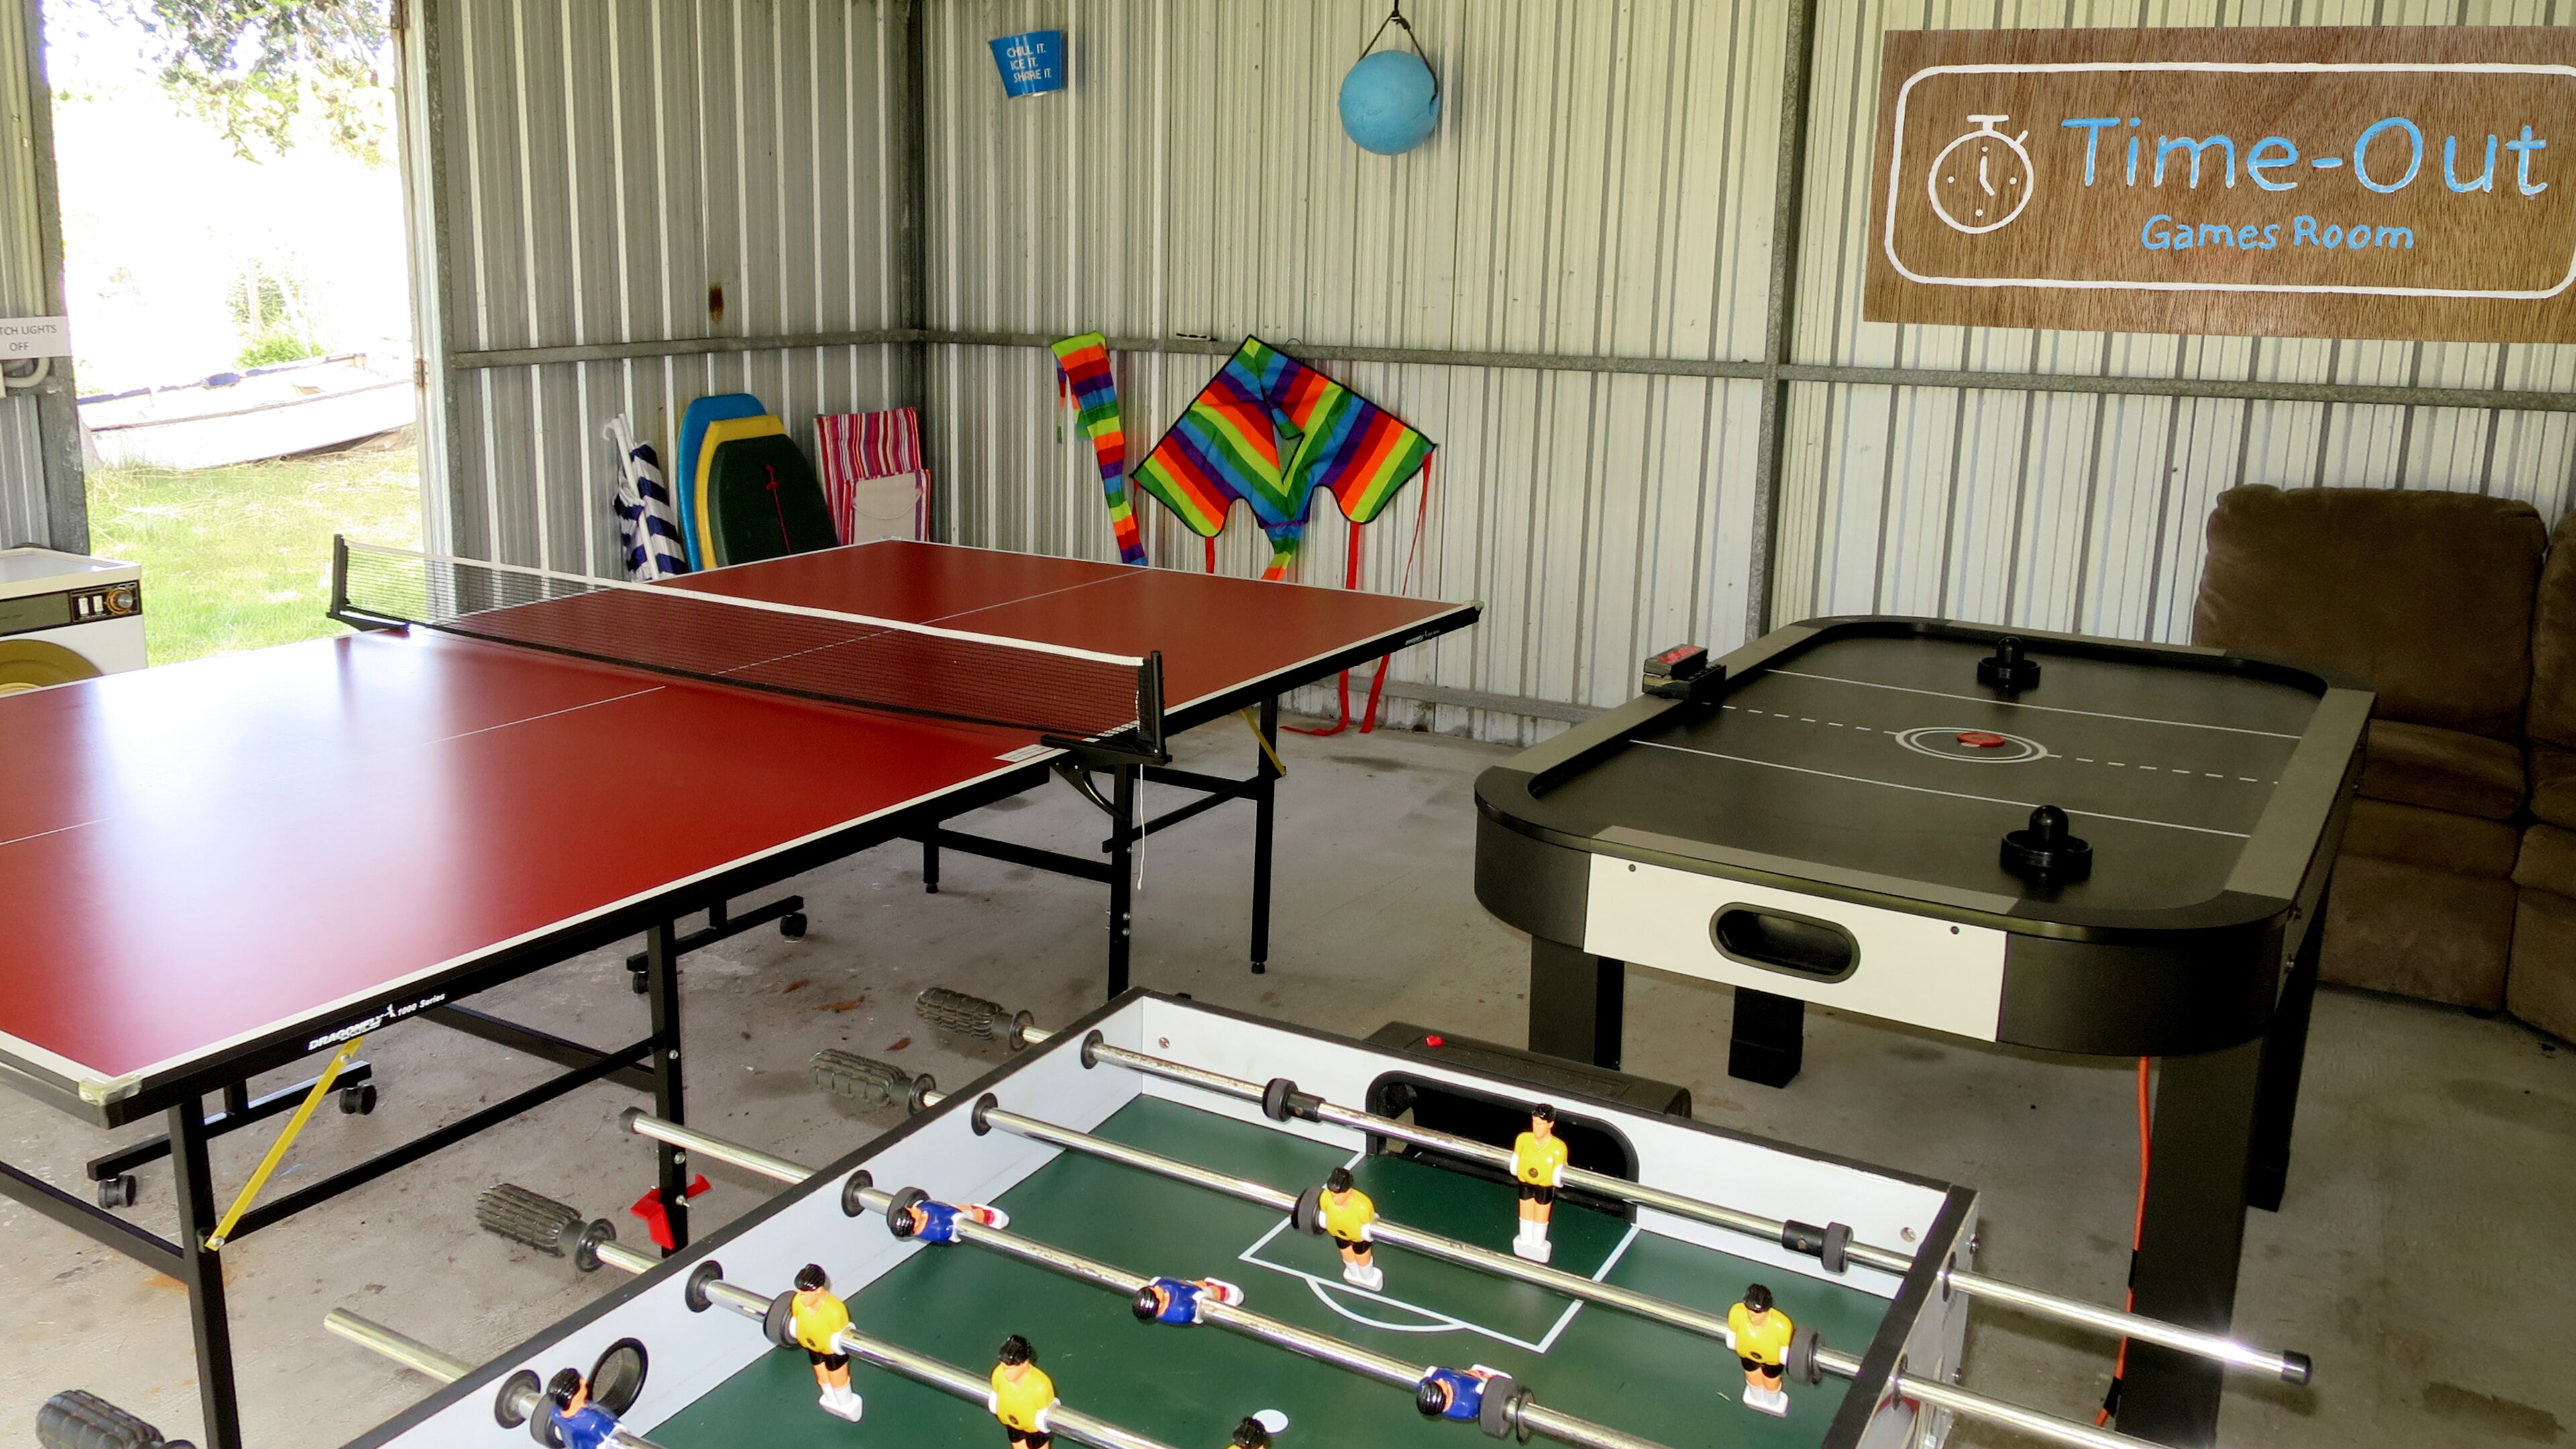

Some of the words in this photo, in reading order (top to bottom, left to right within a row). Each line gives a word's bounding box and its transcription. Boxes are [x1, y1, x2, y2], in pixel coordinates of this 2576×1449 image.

[1006, 46, 1034, 58] CHILL
[1036, 43, 1046, 54] IT.
[1010, 58, 1025, 70] ICE
[1028, 57, 1038, 68] IT.
[1013, 69, 1042, 83] SHARE
[2061, 117, 2548, 195] Time-Out
[2141, 214, 2281, 250] Games
[2293, 215, 2414, 250] Room
[21, 325, 57, 335] LIGHTS
[9, 341, 30, 352] OFF
[398, 1003, 417, 1016] 1000
[419, 994, 445, 1008] Series
